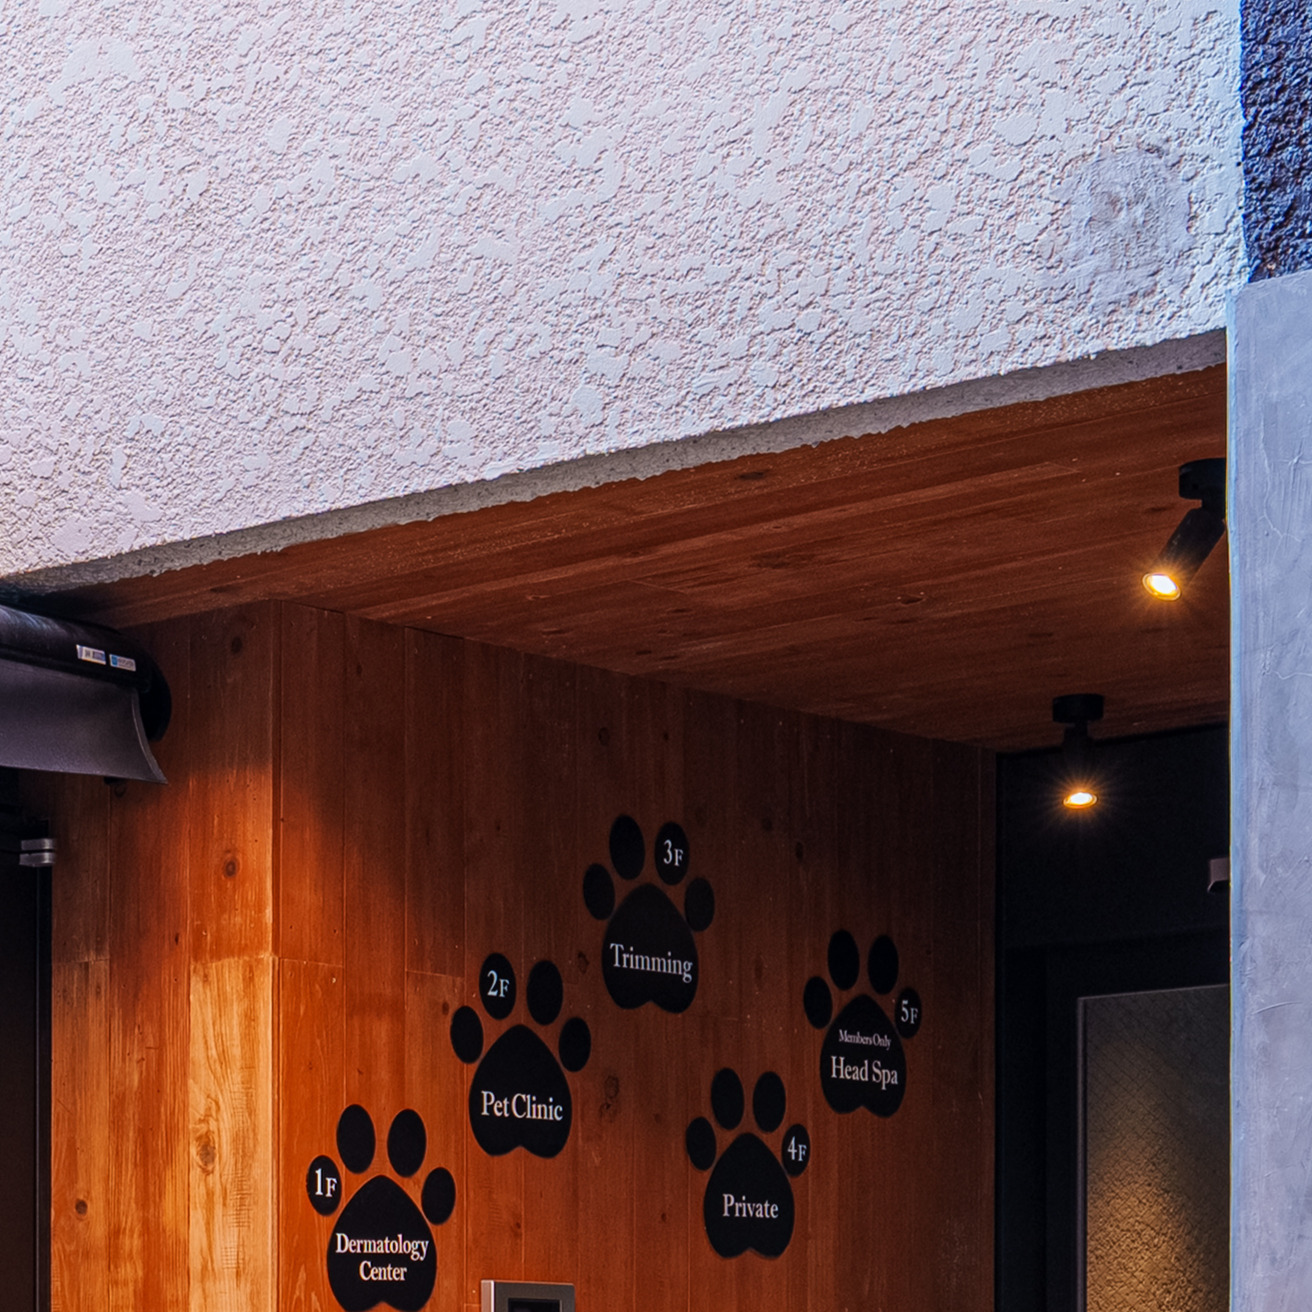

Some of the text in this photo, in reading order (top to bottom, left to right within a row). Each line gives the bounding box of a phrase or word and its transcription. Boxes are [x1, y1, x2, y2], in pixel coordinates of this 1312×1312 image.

[663, 839, 684, 867] 3F
[609, 943, 693, 984] Trimming
[487, 970, 510, 998] 2F
[900, 999, 919, 1025] 5F
[838, 1029, 892, 1051] Members Only
[831, 1055, 899, 1091] Head Spa
[481, 1090, 564, 1122] Pet Clinic
[787, 1135, 807, 1162] 4F
[314, 1167, 338, 1197] 1F
[722, 1193, 779, 1219] Private
[335, 1232, 430, 1261] Dermatology
[359, 1260, 408, 1281] Center
